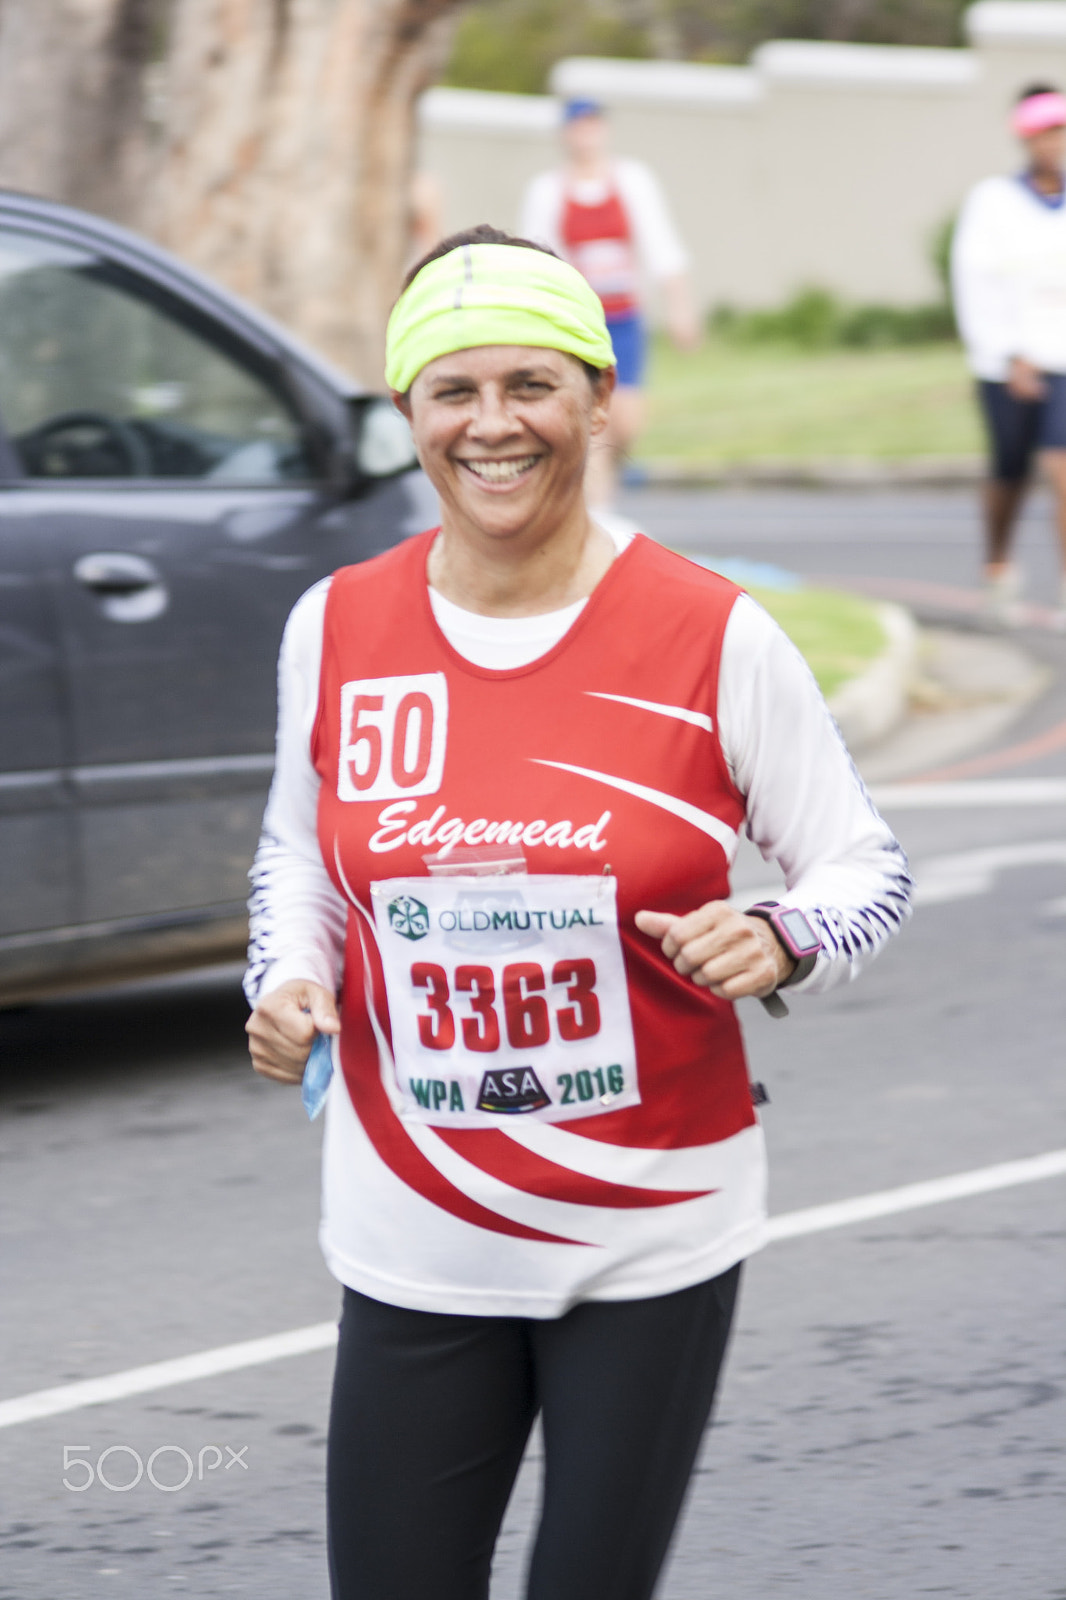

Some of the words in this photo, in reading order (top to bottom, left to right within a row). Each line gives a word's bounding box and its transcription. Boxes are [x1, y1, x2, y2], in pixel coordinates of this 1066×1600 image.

[348, 692, 433, 791] 50
[369, 800, 611, 859] Edgemead
[411, 958, 600, 1053] 3363
[410, 1077, 465, 1112] WPA
[483, 1072, 540, 1097] ASA
[557, 1064, 625, 1104] 2016
